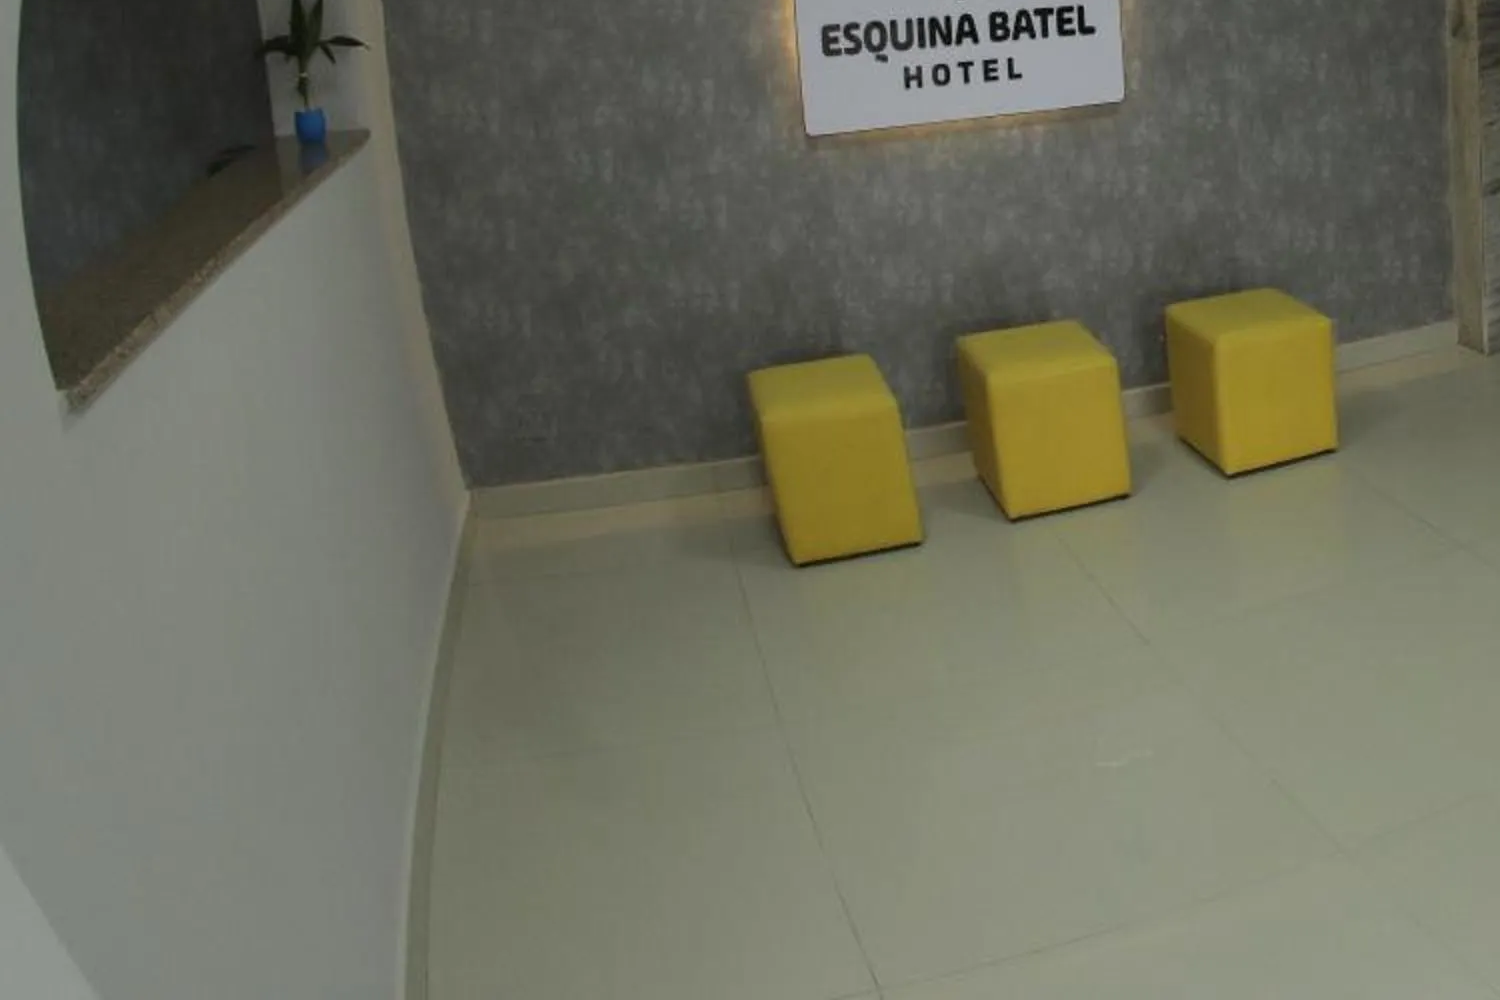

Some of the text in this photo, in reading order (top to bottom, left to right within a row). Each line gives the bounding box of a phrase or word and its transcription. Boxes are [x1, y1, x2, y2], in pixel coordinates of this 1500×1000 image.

[820, 4, 1096, 63] ESQUINA BATEL
[903, 56, 1023, 90] HOTEL
